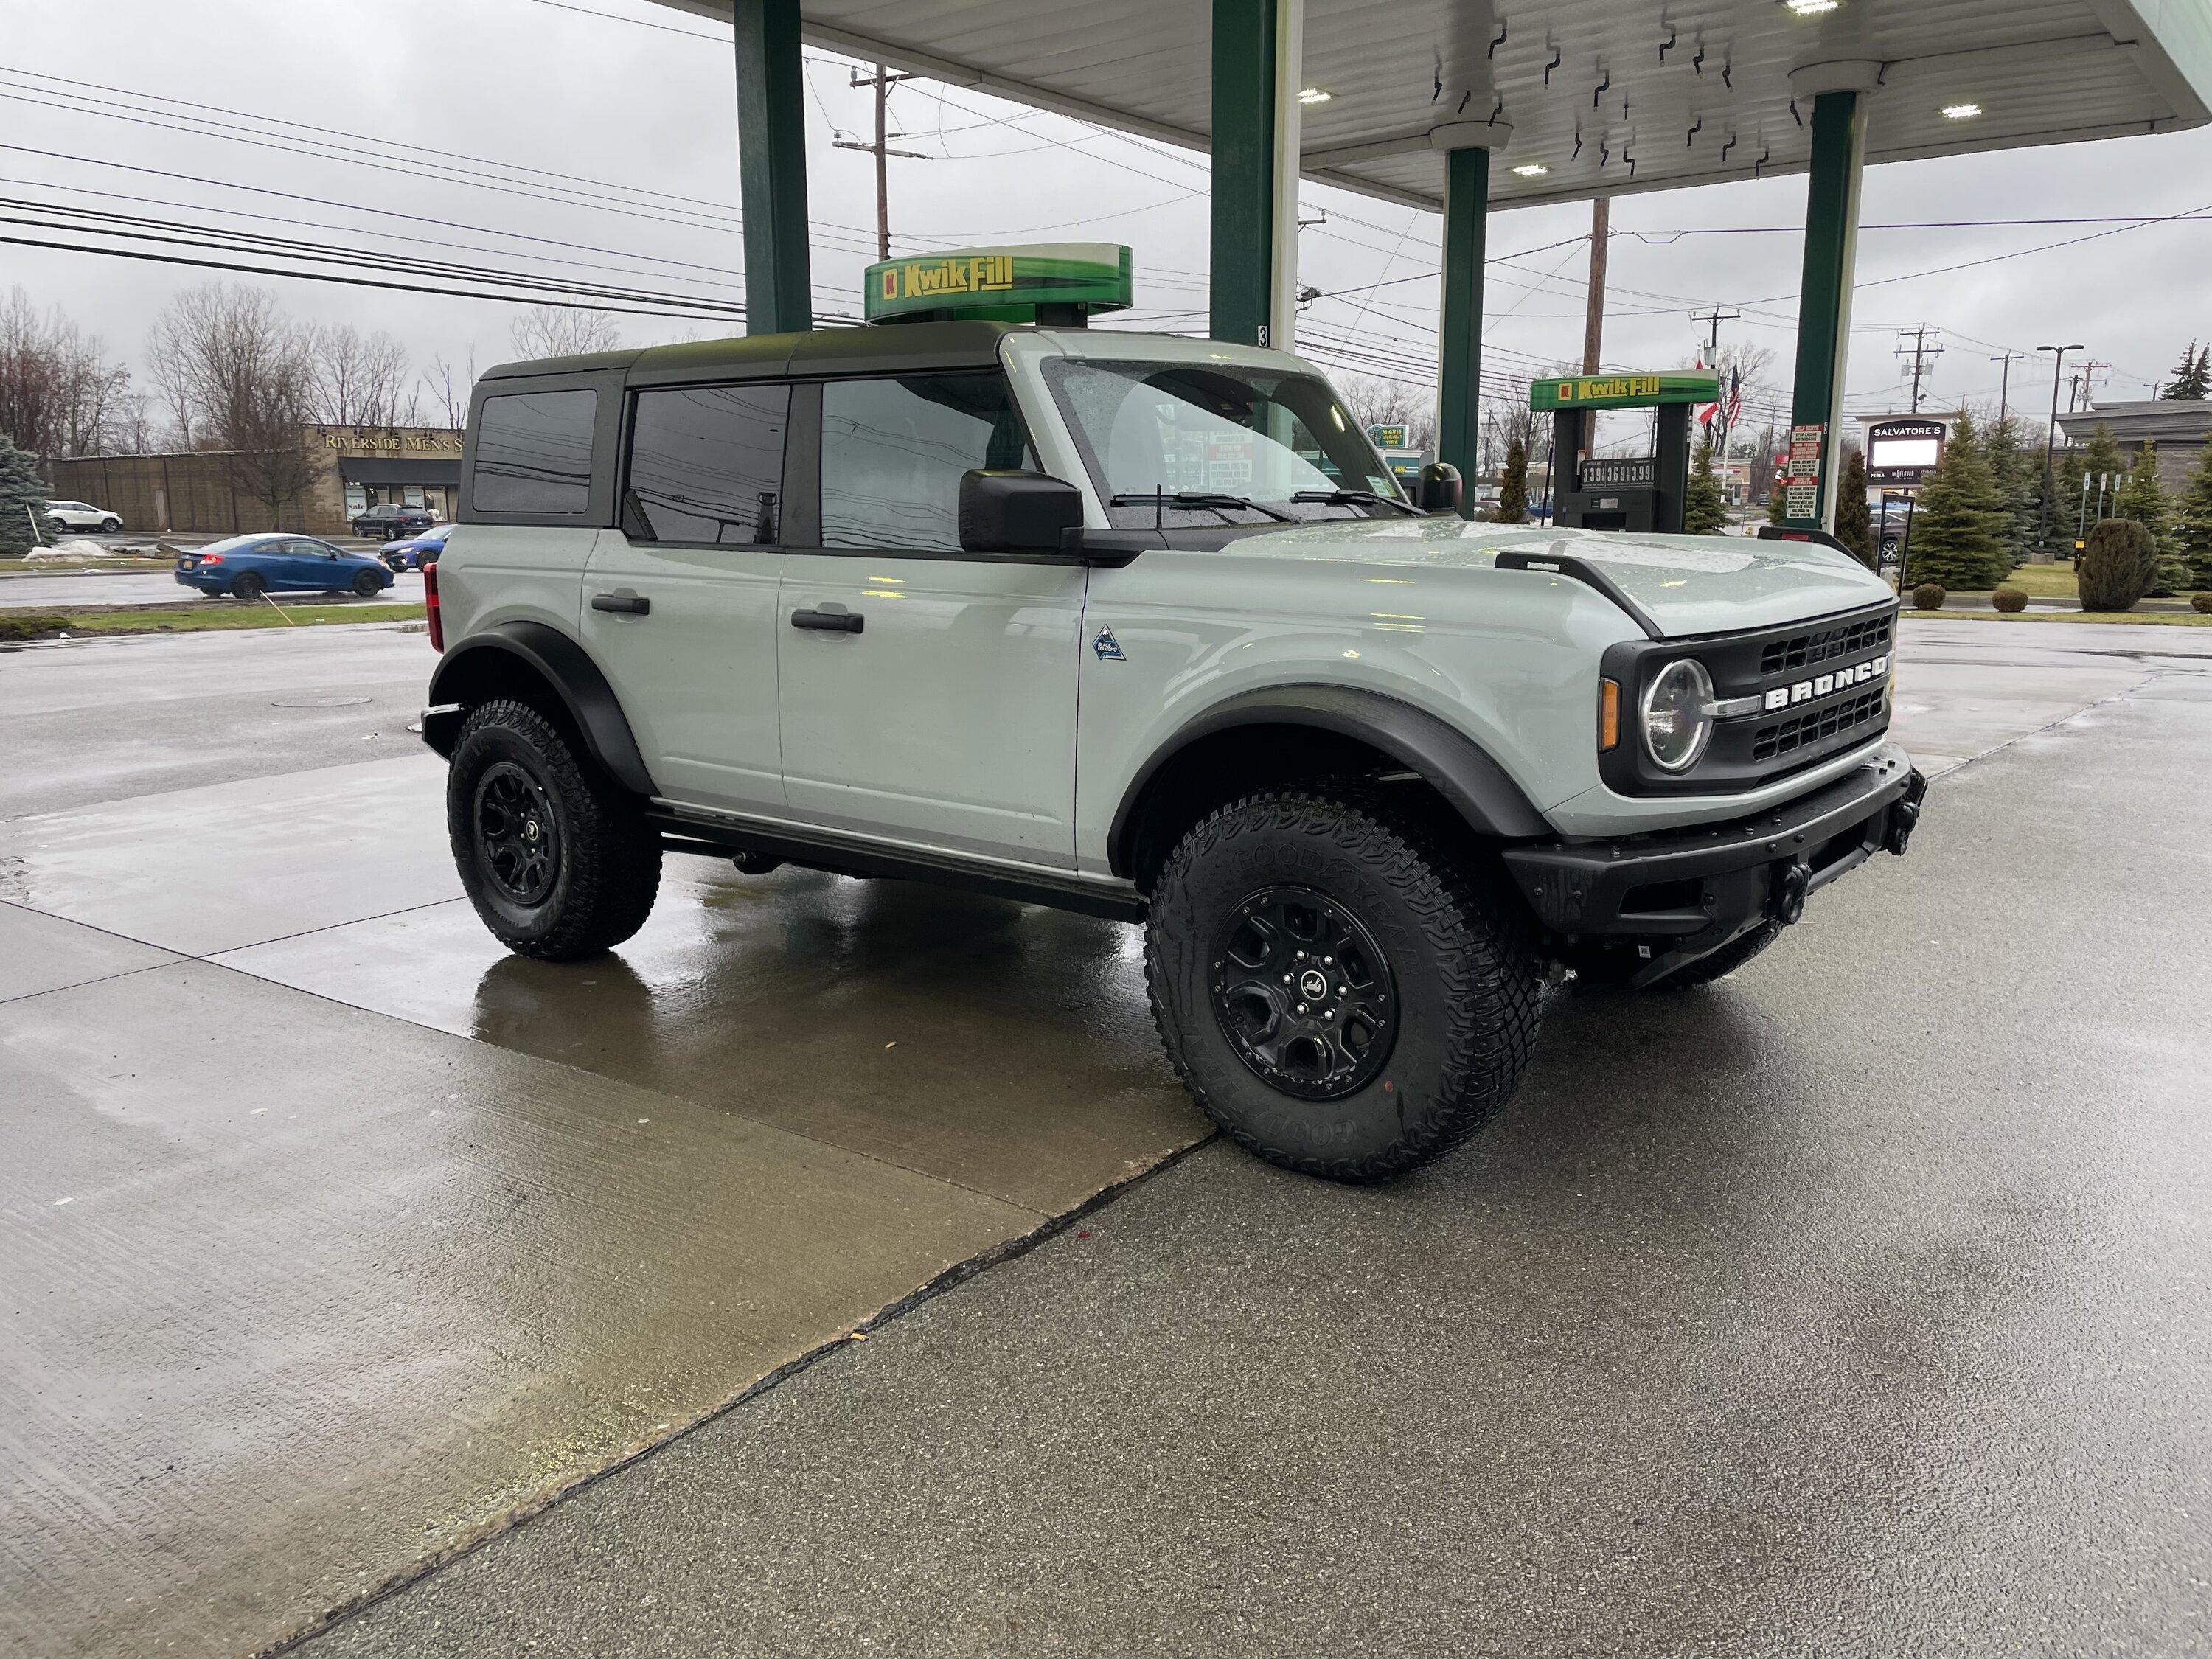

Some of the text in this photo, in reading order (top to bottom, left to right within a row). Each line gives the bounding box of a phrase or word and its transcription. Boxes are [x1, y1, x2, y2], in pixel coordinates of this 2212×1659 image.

[905, 260, 967, 298] Kwik
[970, 256, 1013, 291] Fill
[1260, 327, 1267, 347] 3
[1579, 378, 1628, 399] Kwik
[1630, 377, 1660, 396] Fill
[1874, 426, 1941, 437] SALVATORE'S
[325, 435, 400, 450] RIVERSIDE
[406, 437, 450, 451] MEN'S
[1765, 656, 1887, 710] BRONCO
[1232, 844, 1427, 976] GOODYEAR
